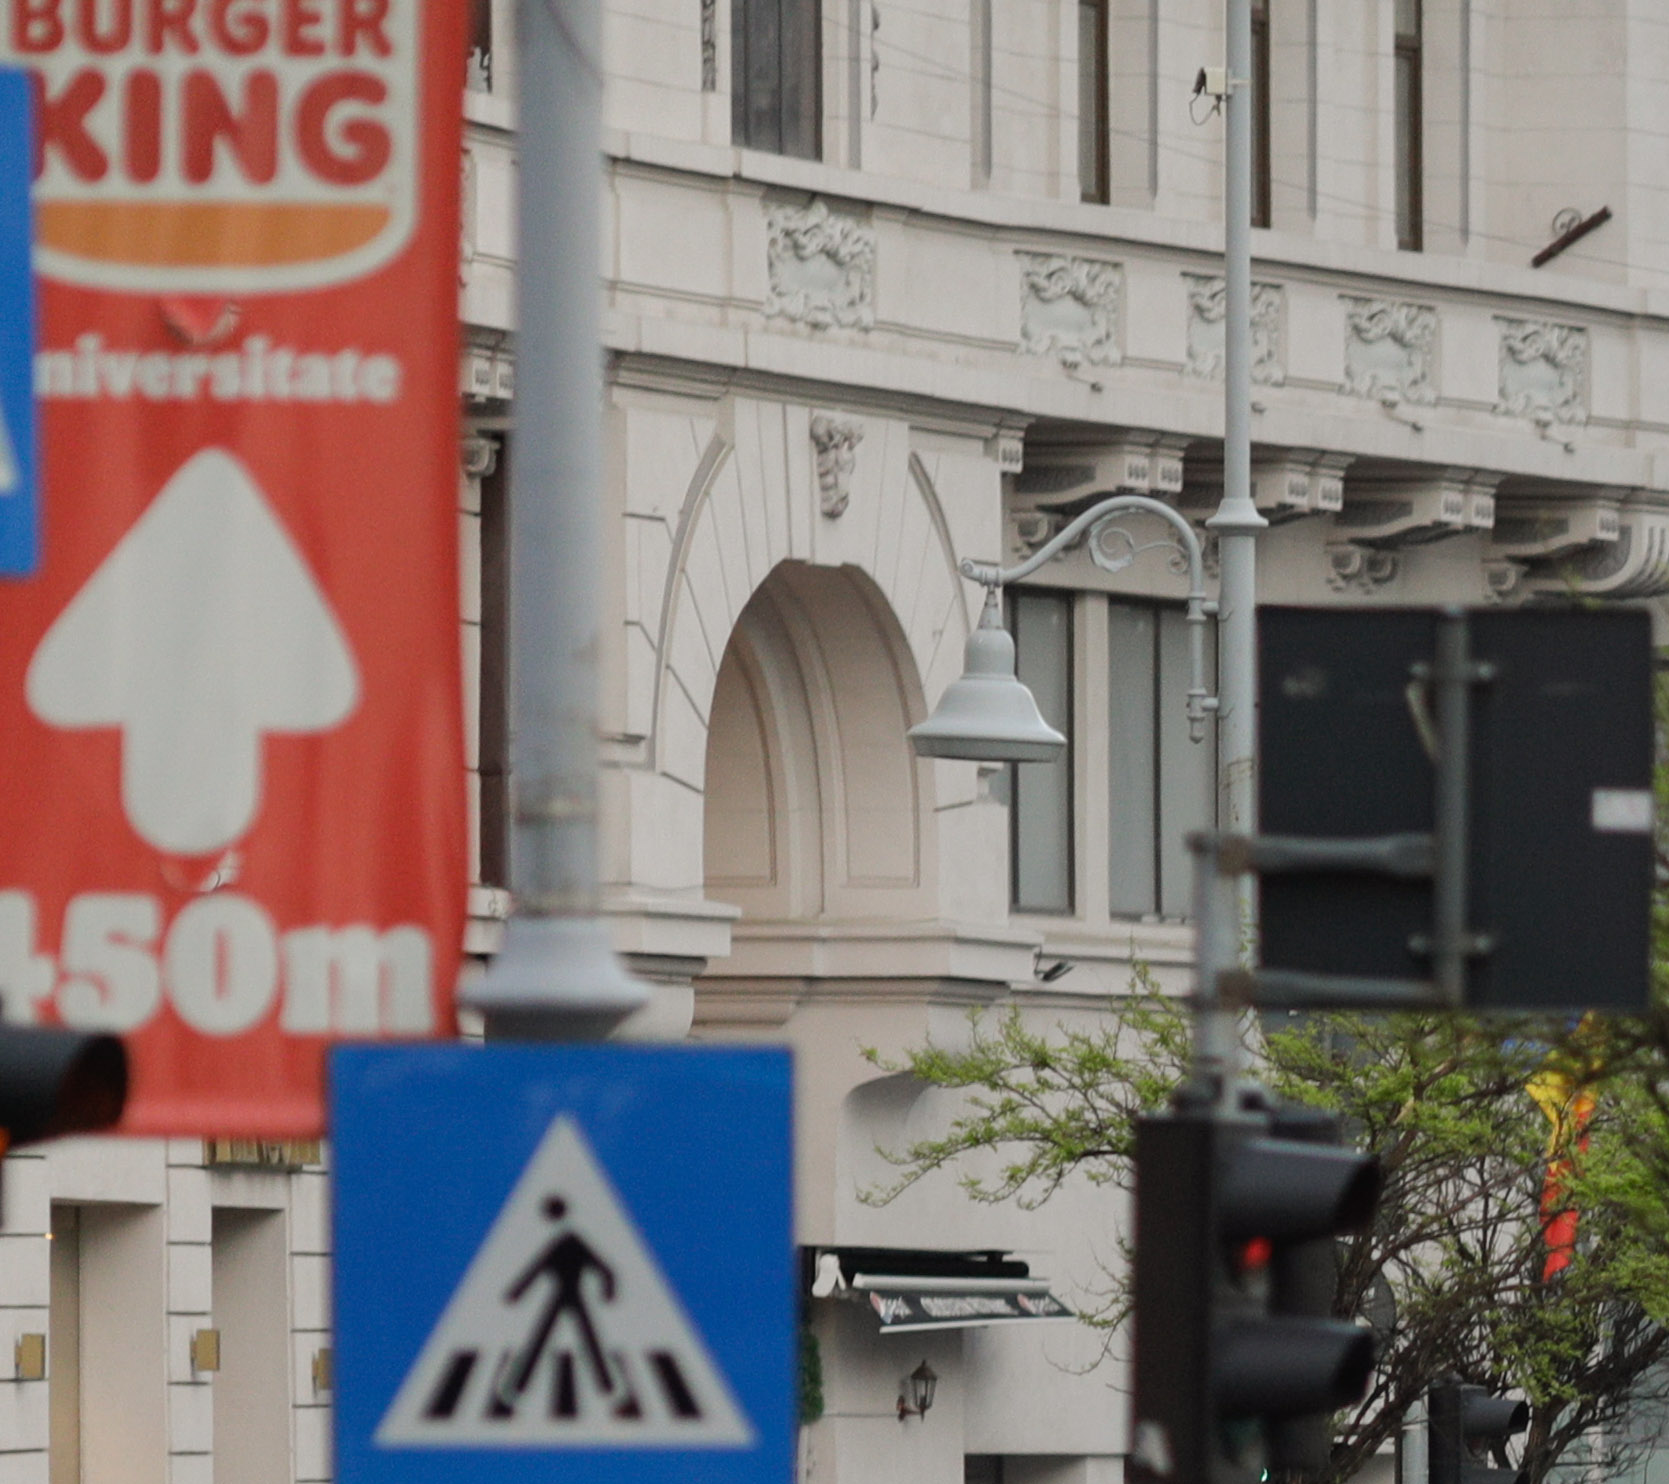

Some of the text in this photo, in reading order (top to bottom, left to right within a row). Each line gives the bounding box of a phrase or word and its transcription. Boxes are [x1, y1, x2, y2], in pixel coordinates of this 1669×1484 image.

[13, 0, 393, 57] BURGER
[30, 65, 395, 188] KING
[34, 332, 402, 404] niversitate
